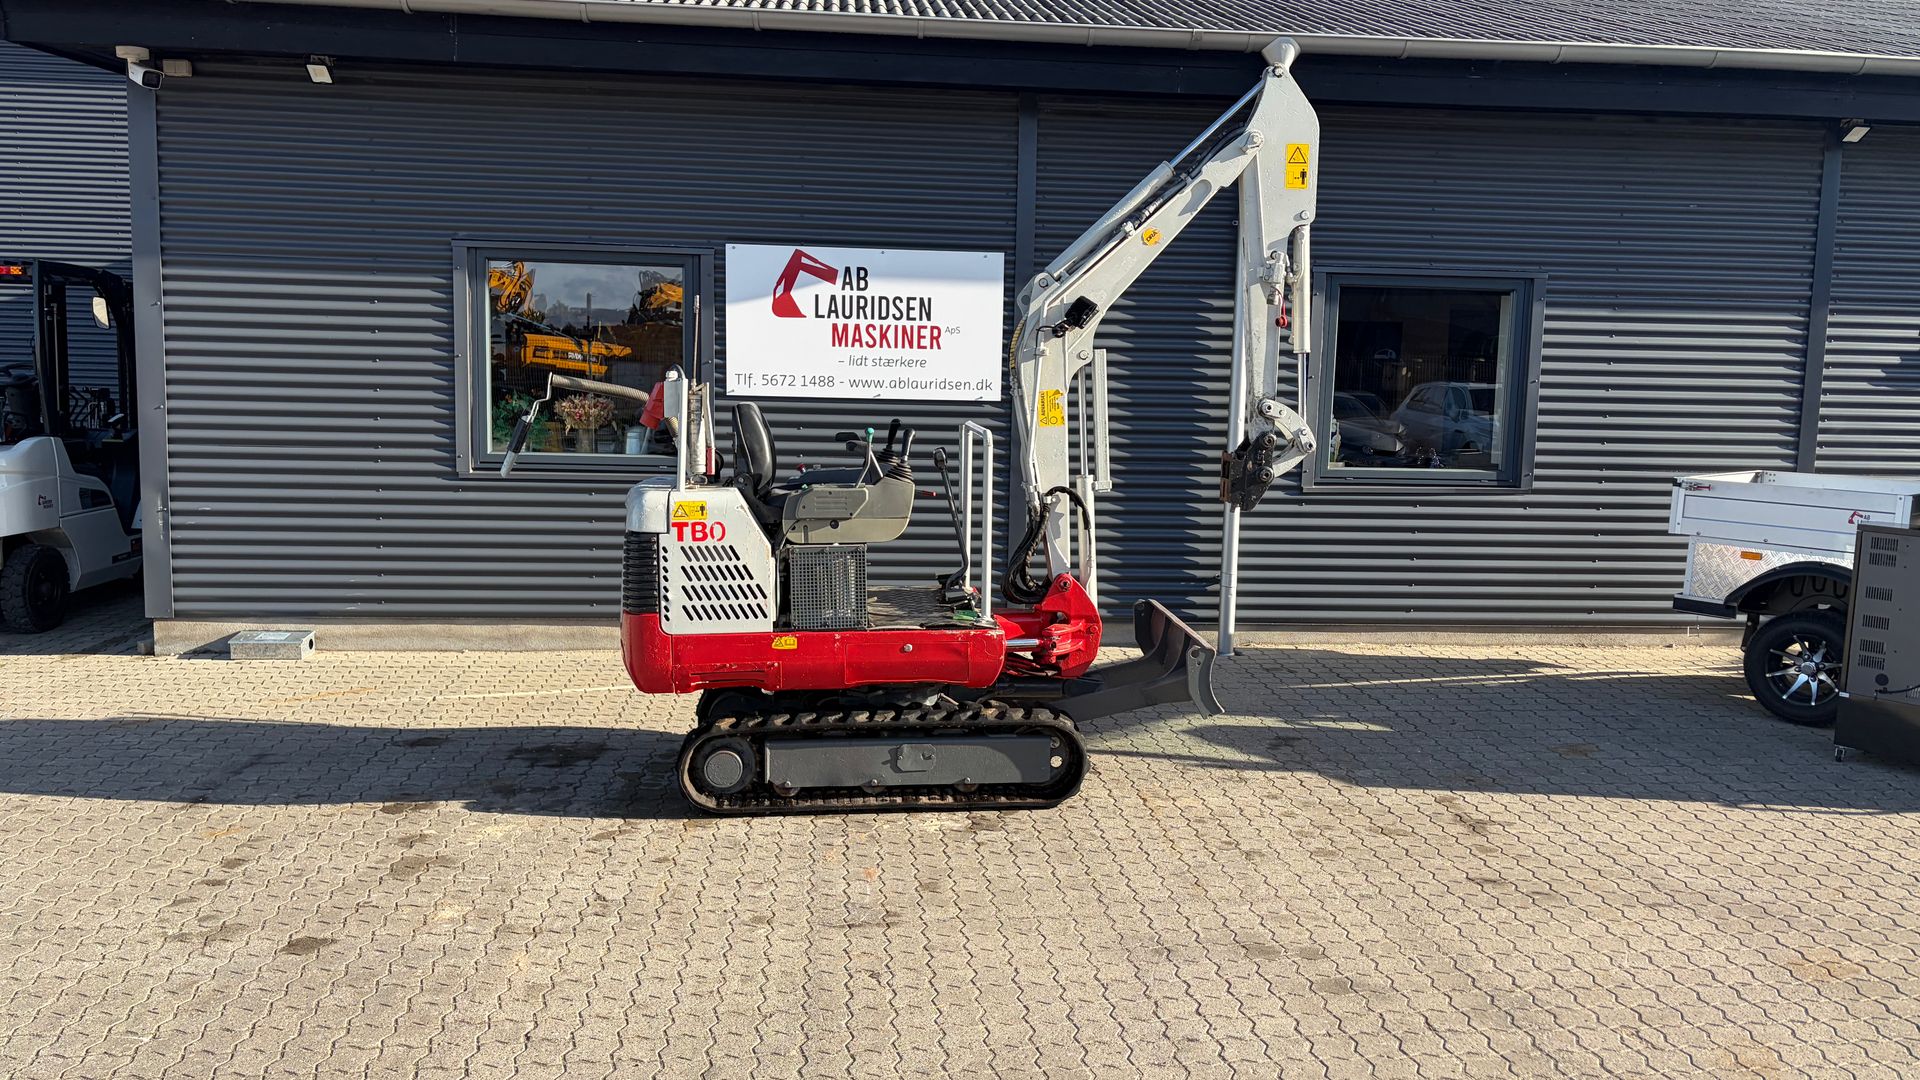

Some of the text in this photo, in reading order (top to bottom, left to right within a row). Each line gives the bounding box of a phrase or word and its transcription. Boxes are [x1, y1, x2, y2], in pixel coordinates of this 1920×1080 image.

[841, 266, 869, 291] AB
[814, 294, 932, 321] LAURIDSEN
[831, 323, 961, 350] MASKINER ApS
[848, 355, 868, 367] lidt
[871, 356, 928, 368] stærkere
[734, 373, 757, 388] Tlf.
[761, 374, 796, 387] 5672
[800, 376, 835, 388] 1488
[848, 377, 993, 391] www.ablauridsen.dk
